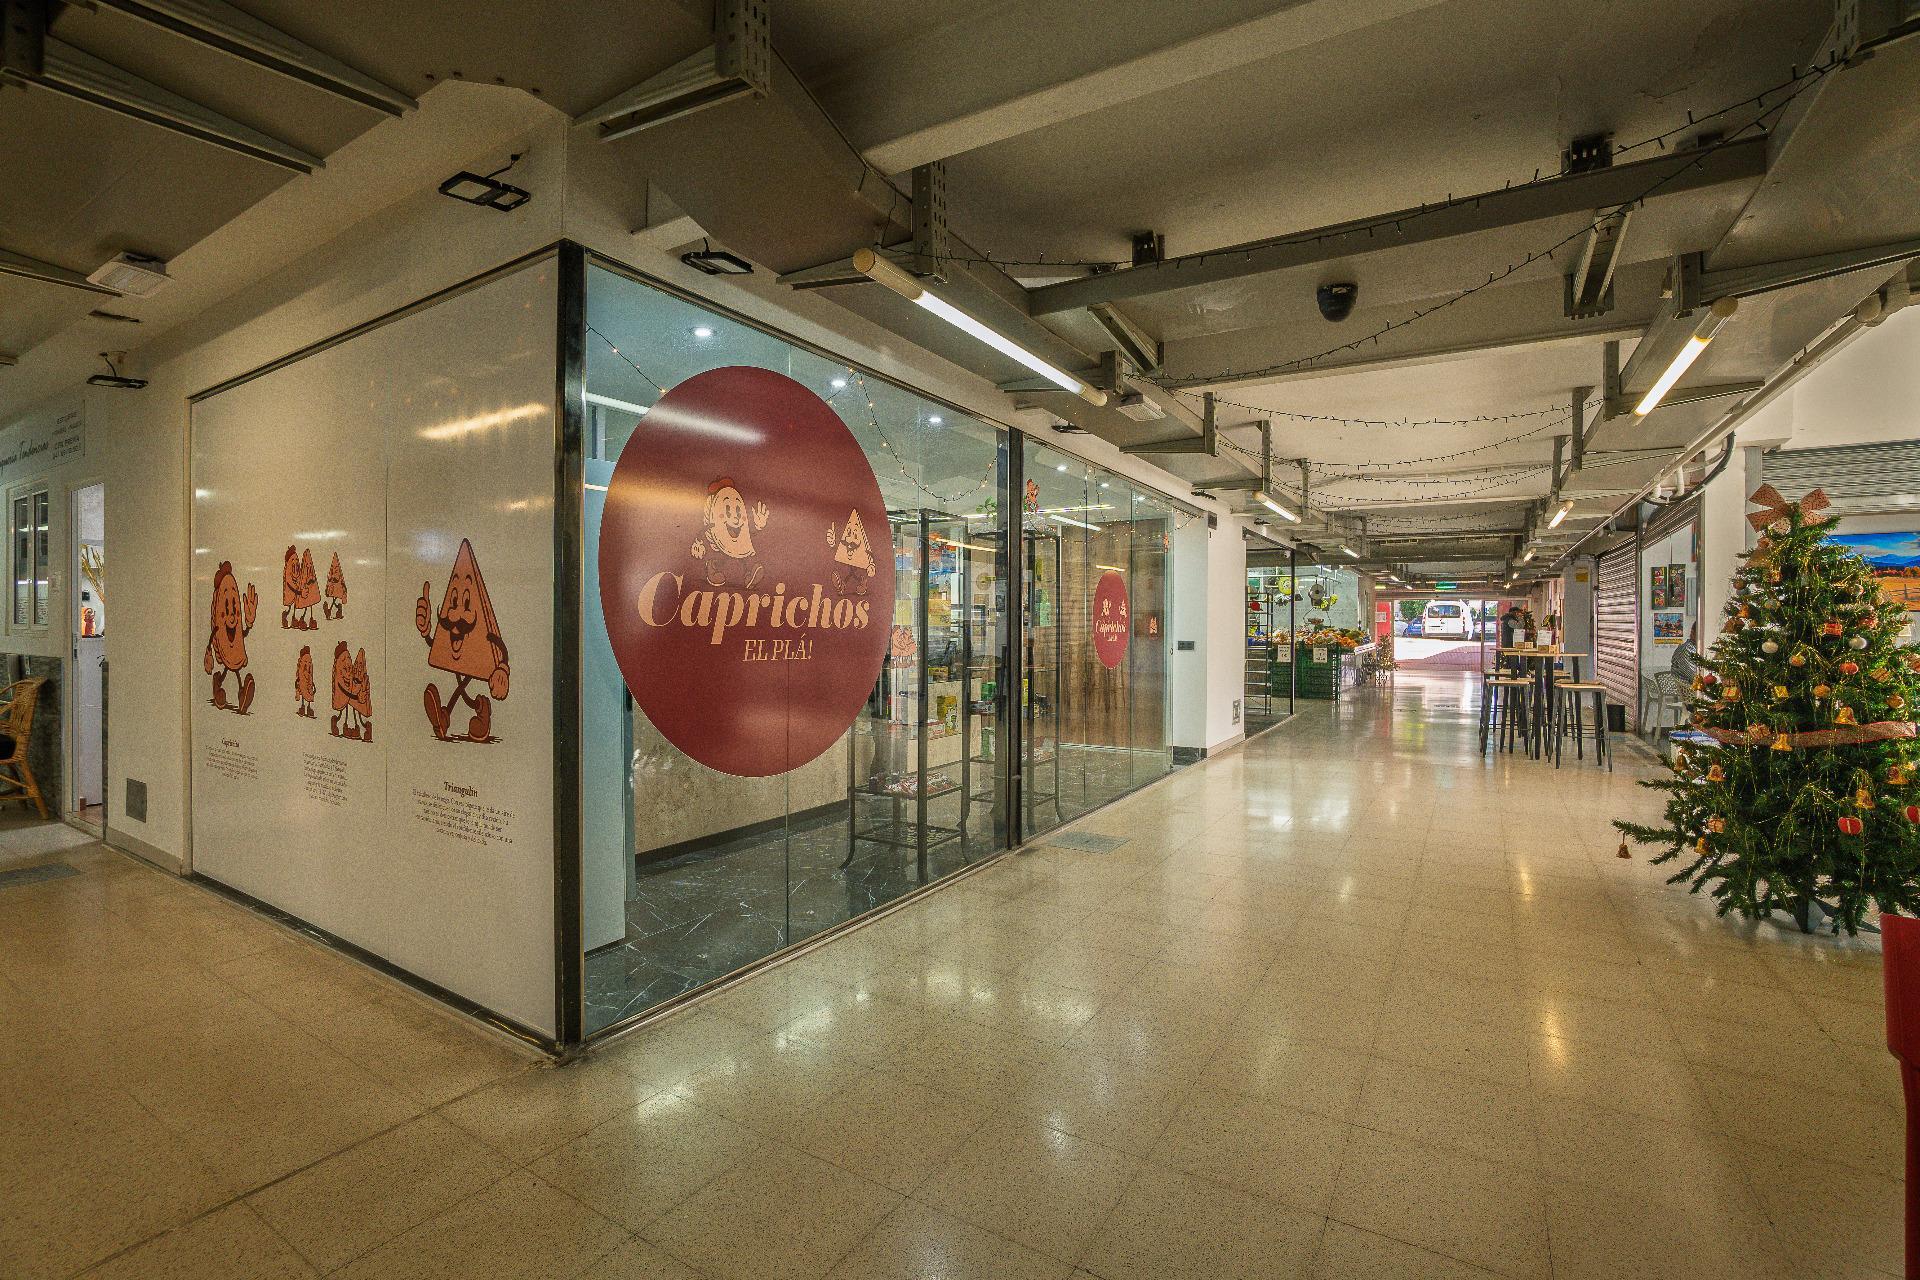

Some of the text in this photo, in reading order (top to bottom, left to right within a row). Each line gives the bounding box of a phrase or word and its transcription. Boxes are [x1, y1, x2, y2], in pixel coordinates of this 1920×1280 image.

[637, 571, 870, 645] Caprichos
[742, 632, 814, 662] EL PLÁ!
